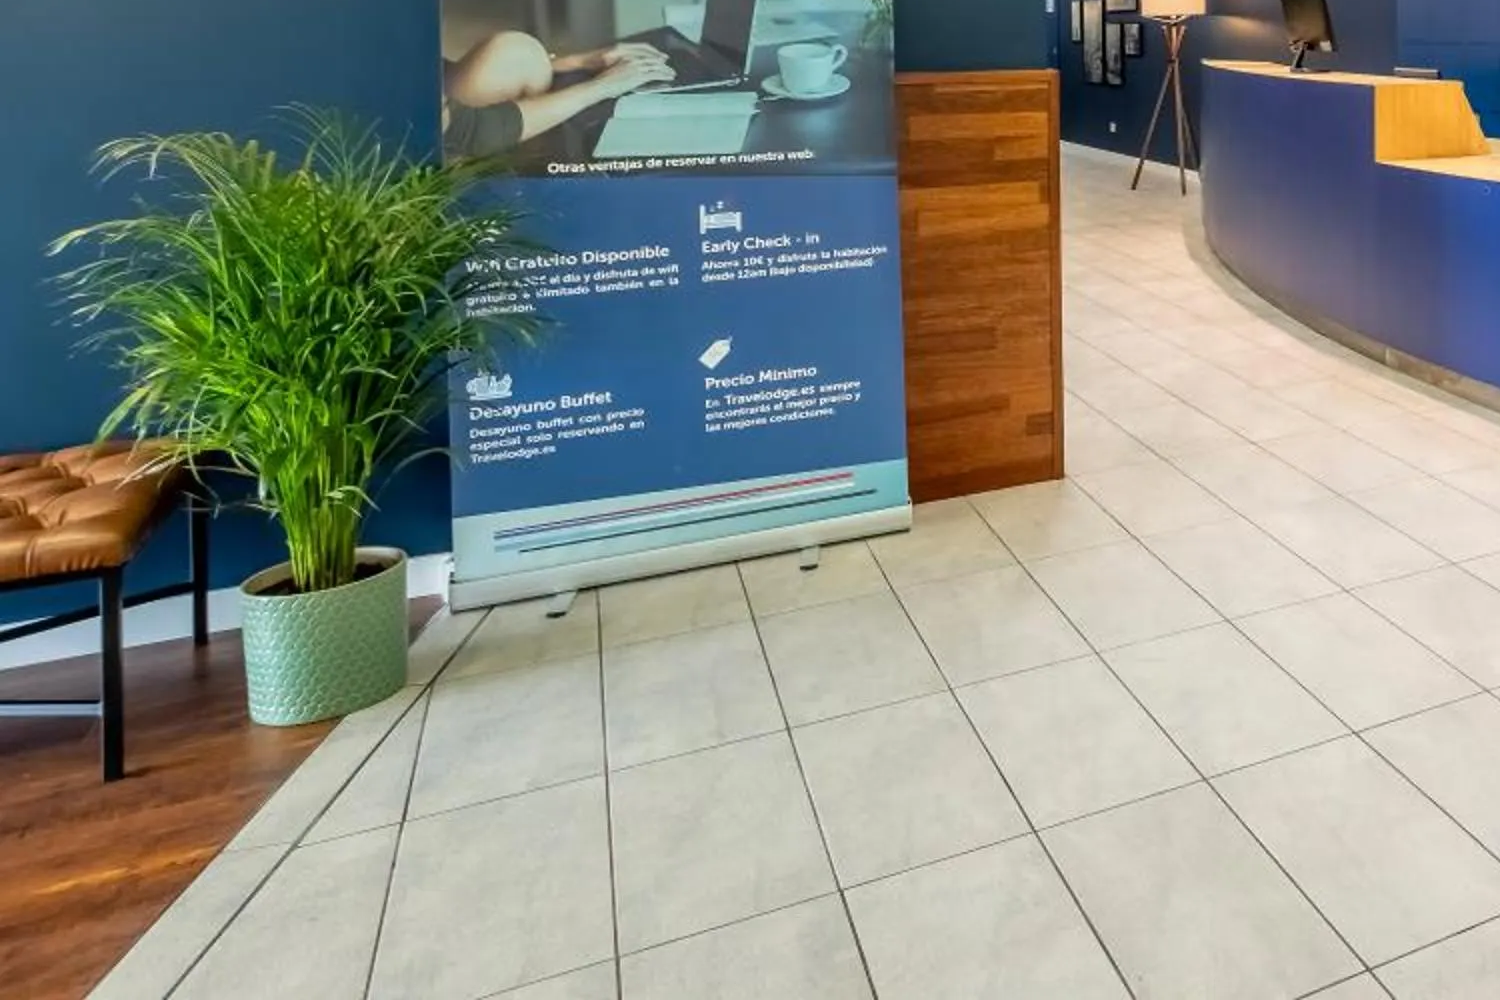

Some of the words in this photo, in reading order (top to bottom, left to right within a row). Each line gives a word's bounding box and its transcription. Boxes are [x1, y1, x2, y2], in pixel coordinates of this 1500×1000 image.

[547, 161, 586, 174] Otras
[588, 158, 644, 171] ventajas
[646, 157, 663, 168] de
[665, 155, 717, 167] reservar
[719, 154, 737, 164] en
[738, 151, 785, 163] nuestra
[702, 238, 740, 255] Early
[743, 234, 792, 250] Check
[805, 231, 820, 245] in
[504, 254, 579, 271] Gratuito
[581, 245, 671, 264] Disponible
[702, 258, 740, 271] Ahorra
[592, 267, 639, 282] disfruta
[640, 266, 656, 277] de
[656, 263, 680, 275] wifi
[649, 278, 666, 288] en
[702, 271, 736, 283] desde
[705, 374, 755, 390] Precio
[469, 398, 557, 421] Desayuno
[560, 390, 613, 409] Buffet
[705, 399, 720, 410] En
[724, 386, 815, 405] Travelodge.es
[469, 422, 532, 440] Desayuno
[536, 416, 574, 430] buffet
[578, 413, 603, 424] con
[606, 406, 646, 422] precio
[469, 435, 522, 452] especial
[525, 431, 553, 445] solo
[557, 421, 626, 440] reservando
[629, 420, 646, 431] en
[469, 446, 557, 464] Travelodge.es
